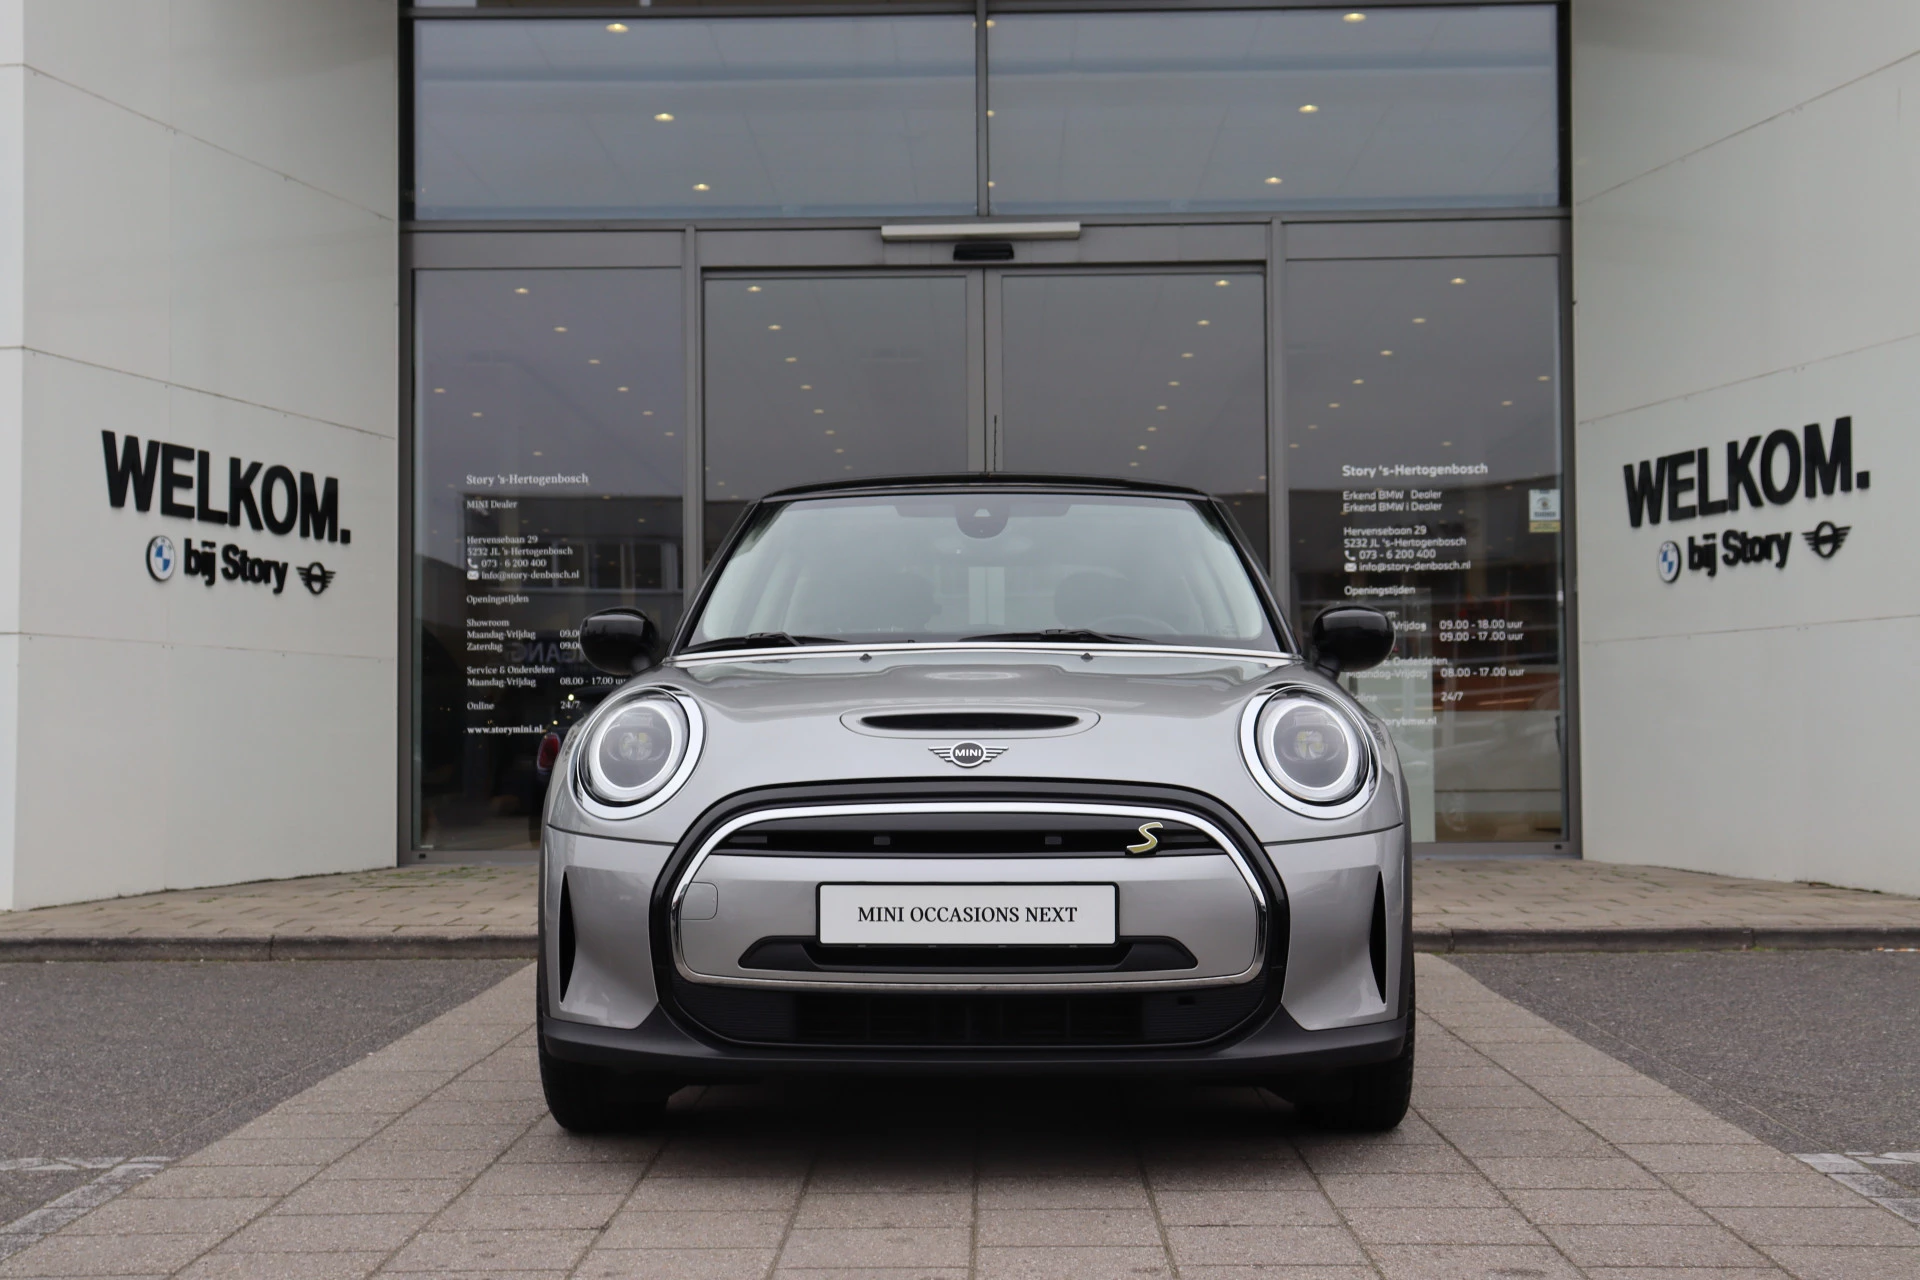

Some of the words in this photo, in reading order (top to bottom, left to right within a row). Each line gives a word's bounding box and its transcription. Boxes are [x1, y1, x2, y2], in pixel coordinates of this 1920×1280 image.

[1342, 465, 1376, 478] Story
[1379, 463, 1488, 477] 's-Hertogenbosch
[1624, 416, 1870, 528] WELKOM.
[466, 474, 494, 486] Story
[498, 473, 590, 486] 's-Hertogenbosch
[102, 430, 350, 544] WELKOM.
[1343, 491, 1376, 500] Erkend
[1378, 490, 1404, 500] BMW
[1410, 490, 1442, 500] Dealer
[466, 500, 488, 508] MINI
[490, 500, 518, 508] Dealer
[1343, 503, 1376, 512] Erkend
[1378, 502, 1404, 512] BMW
[1411, 502, 1442, 511] Dealer
[1344, 527, 1412, 536] Hervensebaan
[1414, 526, 1427, 535] 29
[467, 536, 525, 544] Hervensebaan
[528, 536, 538, 544] 29
[1344, 539, 1367, 548] 5232
[1370, 538, 1380, 548] JL
[467, 548, 488, 556] 5232
[490, 547, 500, 556] JL
[1359, 550, 1377, 560] 073
[1386, 550, 1393, 560] 6
[1394, 550, 1414, 560] 200
[1416, 550, 1436, 559] 400
[1688, 532, 1716, 576] bij
[1722, 530, 1792, 570] Story
[184, 538, 216, 586] bij
[222, 544, 288, 594] Story
[481, 560, 496, 568] 073
[505, 559, 510, 567] 6
[512, 559, 528, 567] 200
[530, 558, 547, 566] 400
[1358, 562, 1471, 572] info@story-denbosch.nl
[482, 570, 580, 581] info@story-denbosch.nl
[1344, 586, 1416, 596] Openingstijden
[466, 595, 529, 604] Openingstijden
[466, 618, 510, 628] Showroom
[1392, 622, 1426, 632] Vrijdag
[1439, 620, 1469, 630] 09.00
[1478, 620, 1504, 629] 18.00
[1440, 632, 1469, 642] 09.00
[1507, 632, 1524, 640] uur
[467, 642, 502, 652] Zaterdag
[467, 666, 498, 674] Service
[507, 665, 554, 674] Onderdelen
[1440, 668, 1470, 677] 08.00
[1508, 668, 1524, 676] uur
[560, 678, 584, 686] 08.00
[592, 677, 613, 686] 17.00
[1440, 692, 1464, 702] 24/7
[467, 702, 494, 710] Online
[560, 701, 580, 710] 24/7
[468, 725, 542, 735] www.storymini.nl
[1126, 822, 1164, 854] S
[858, 906, 904, 922] MINI
[910, 906, 1019, 922] OCCASIONS
[1026, 906, 1078, 922] NEXT
